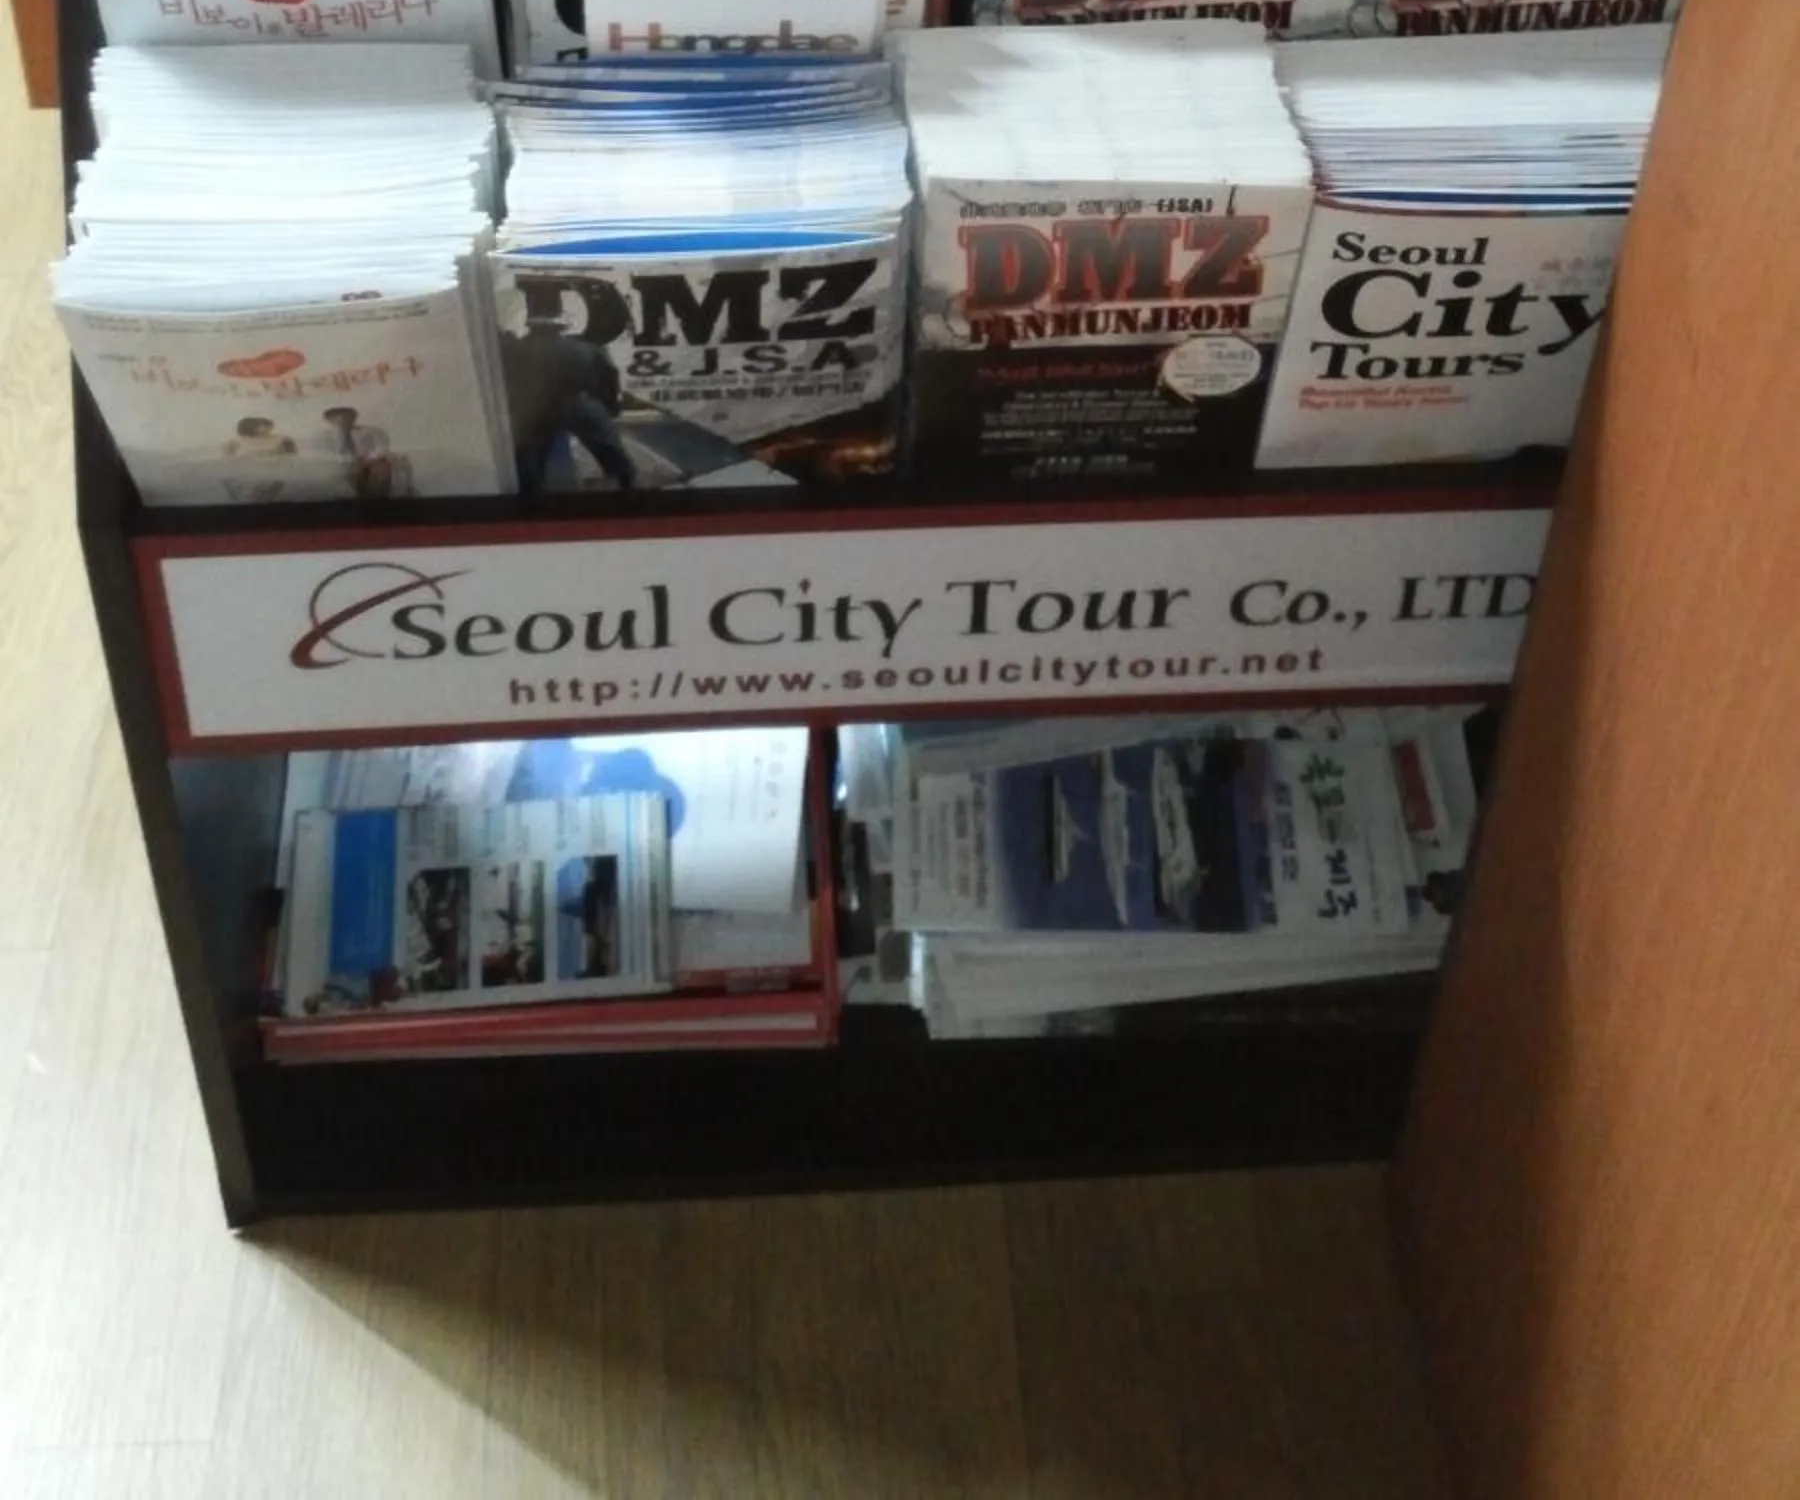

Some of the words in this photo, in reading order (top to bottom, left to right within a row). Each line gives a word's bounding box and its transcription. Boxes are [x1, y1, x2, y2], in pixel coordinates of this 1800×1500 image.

[957, 215, 1270, 316] DMZ
[1332, 231, 1489, 266] Seoul
[514, 258, 878, 347] DMZ
[969, 303, 1253, 346] PANMUNJEOM
[1321, 269, 1607, 357] City
[626, 349, 673, 377] &
[1310, 341, 1526, 381] Tours
[391, 584, 678, 661] Seoul
[707, 578, 924, 658] City
[945, 579, 1191, 637] Tour
[1229, 578, 1368, 632] Co.,
[509, 646, 1325, 707] http://www.seoulcitytour.net
